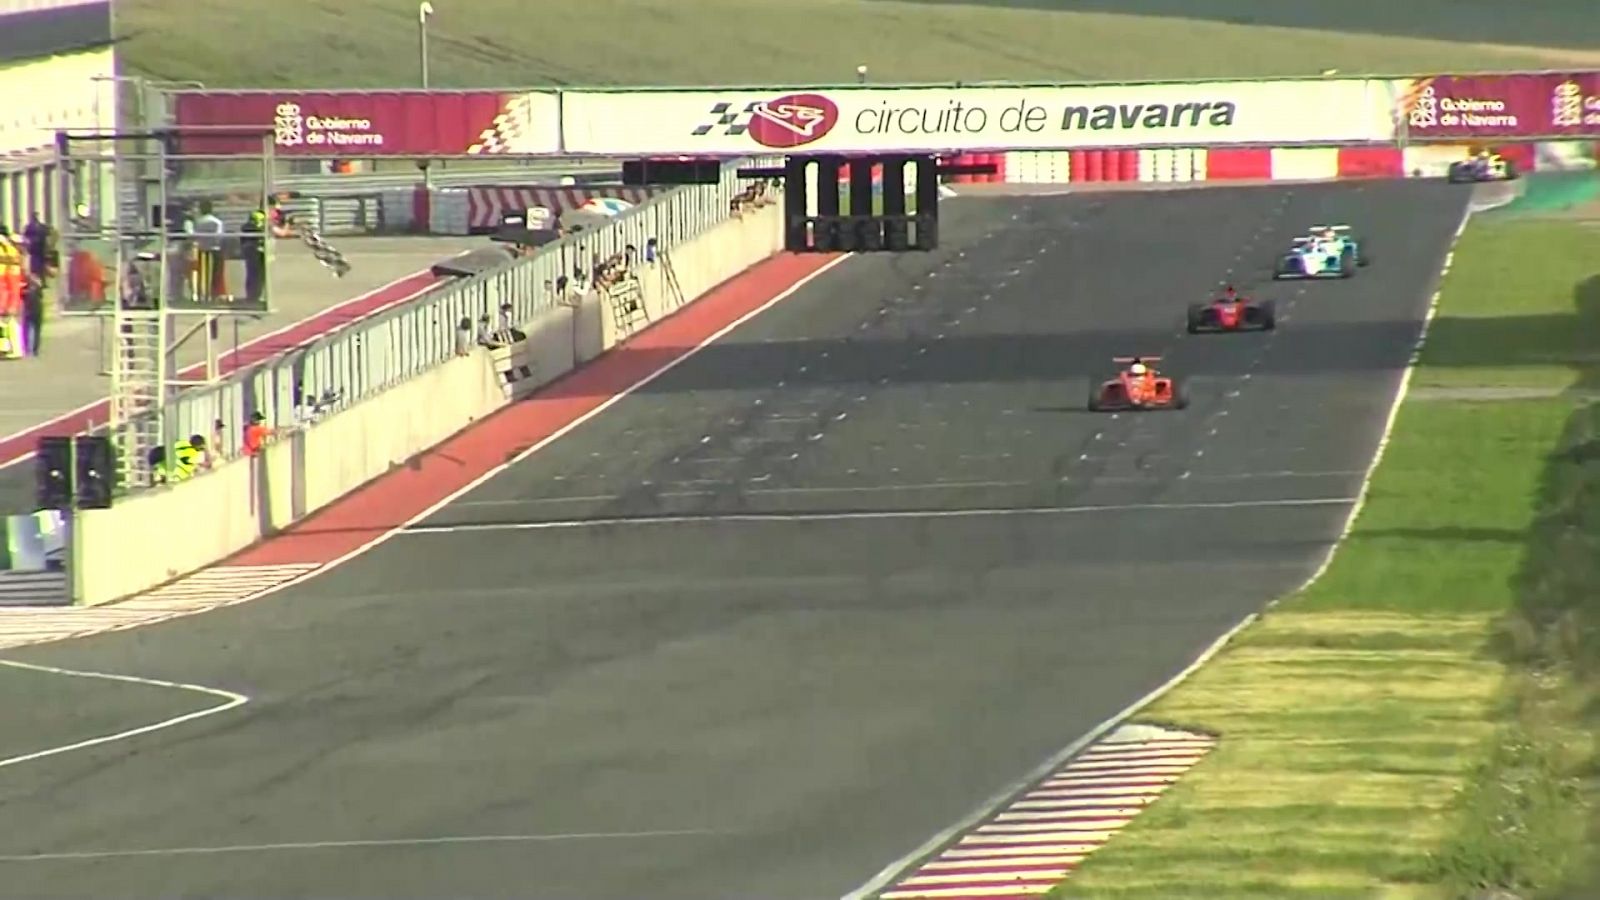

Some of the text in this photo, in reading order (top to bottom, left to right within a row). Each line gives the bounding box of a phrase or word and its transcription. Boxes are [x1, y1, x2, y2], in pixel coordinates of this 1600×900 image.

[1440, 98, 1505, 111] Gobierno
[306, 116, 371, 130] Gobierno
[855, 98, 1236, 134] circuito de navarra
[1440, 114, 1517, 127] de Navarra
[306, 132, 383, 146] de Navarra
